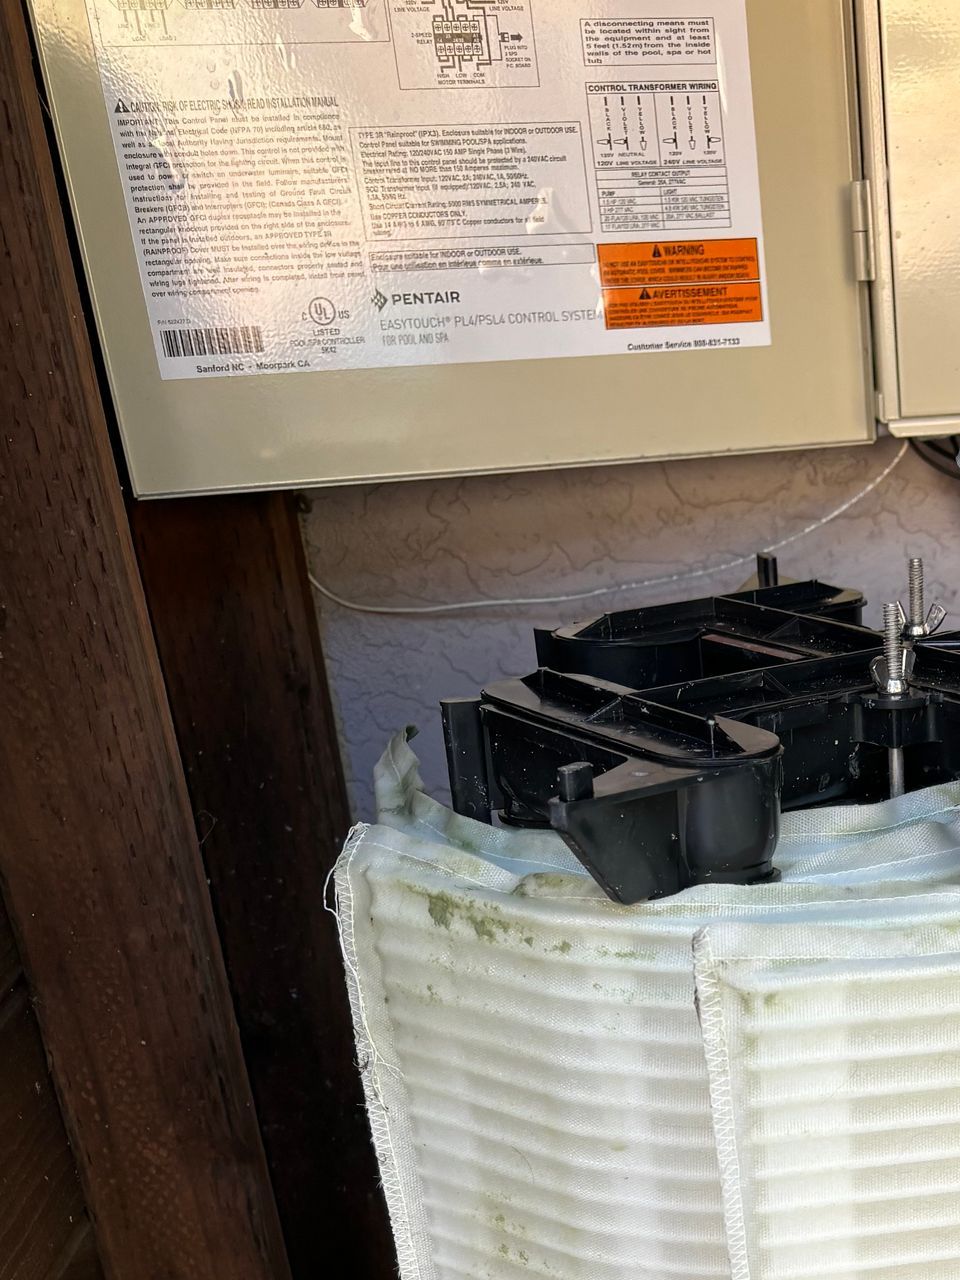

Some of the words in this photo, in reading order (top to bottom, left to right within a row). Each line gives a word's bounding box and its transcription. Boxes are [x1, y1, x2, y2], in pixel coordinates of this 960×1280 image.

[189, 100, 220, 110] ELECTRIC
[266, 98, 310, 108] INSTALLATION
[440, 250, 464, 259] INDOOR
[474, 249, 505, 258] OUTDOOR
[664, 244, 704, 256] WARNING
[391, 291, 460, 306] PENTAIR
[653, 287, 727, 299] AVERTISSEMENT
[338, 310, 349, 319] US
[454, 314, 505, 328] PL4/PSL4
[508, 312, 558, 326] CONTROL
[398, 334, 416, 344] POOL
[419, 333, 433, 343] AND
[435, 332, 450, 342] SPA
[197, 364, 229, 373] Sanford
[231, 363, 244, 371] NC
[256, 361, 294, 372] Moorpark
[297, 360, 310, 368] CA
